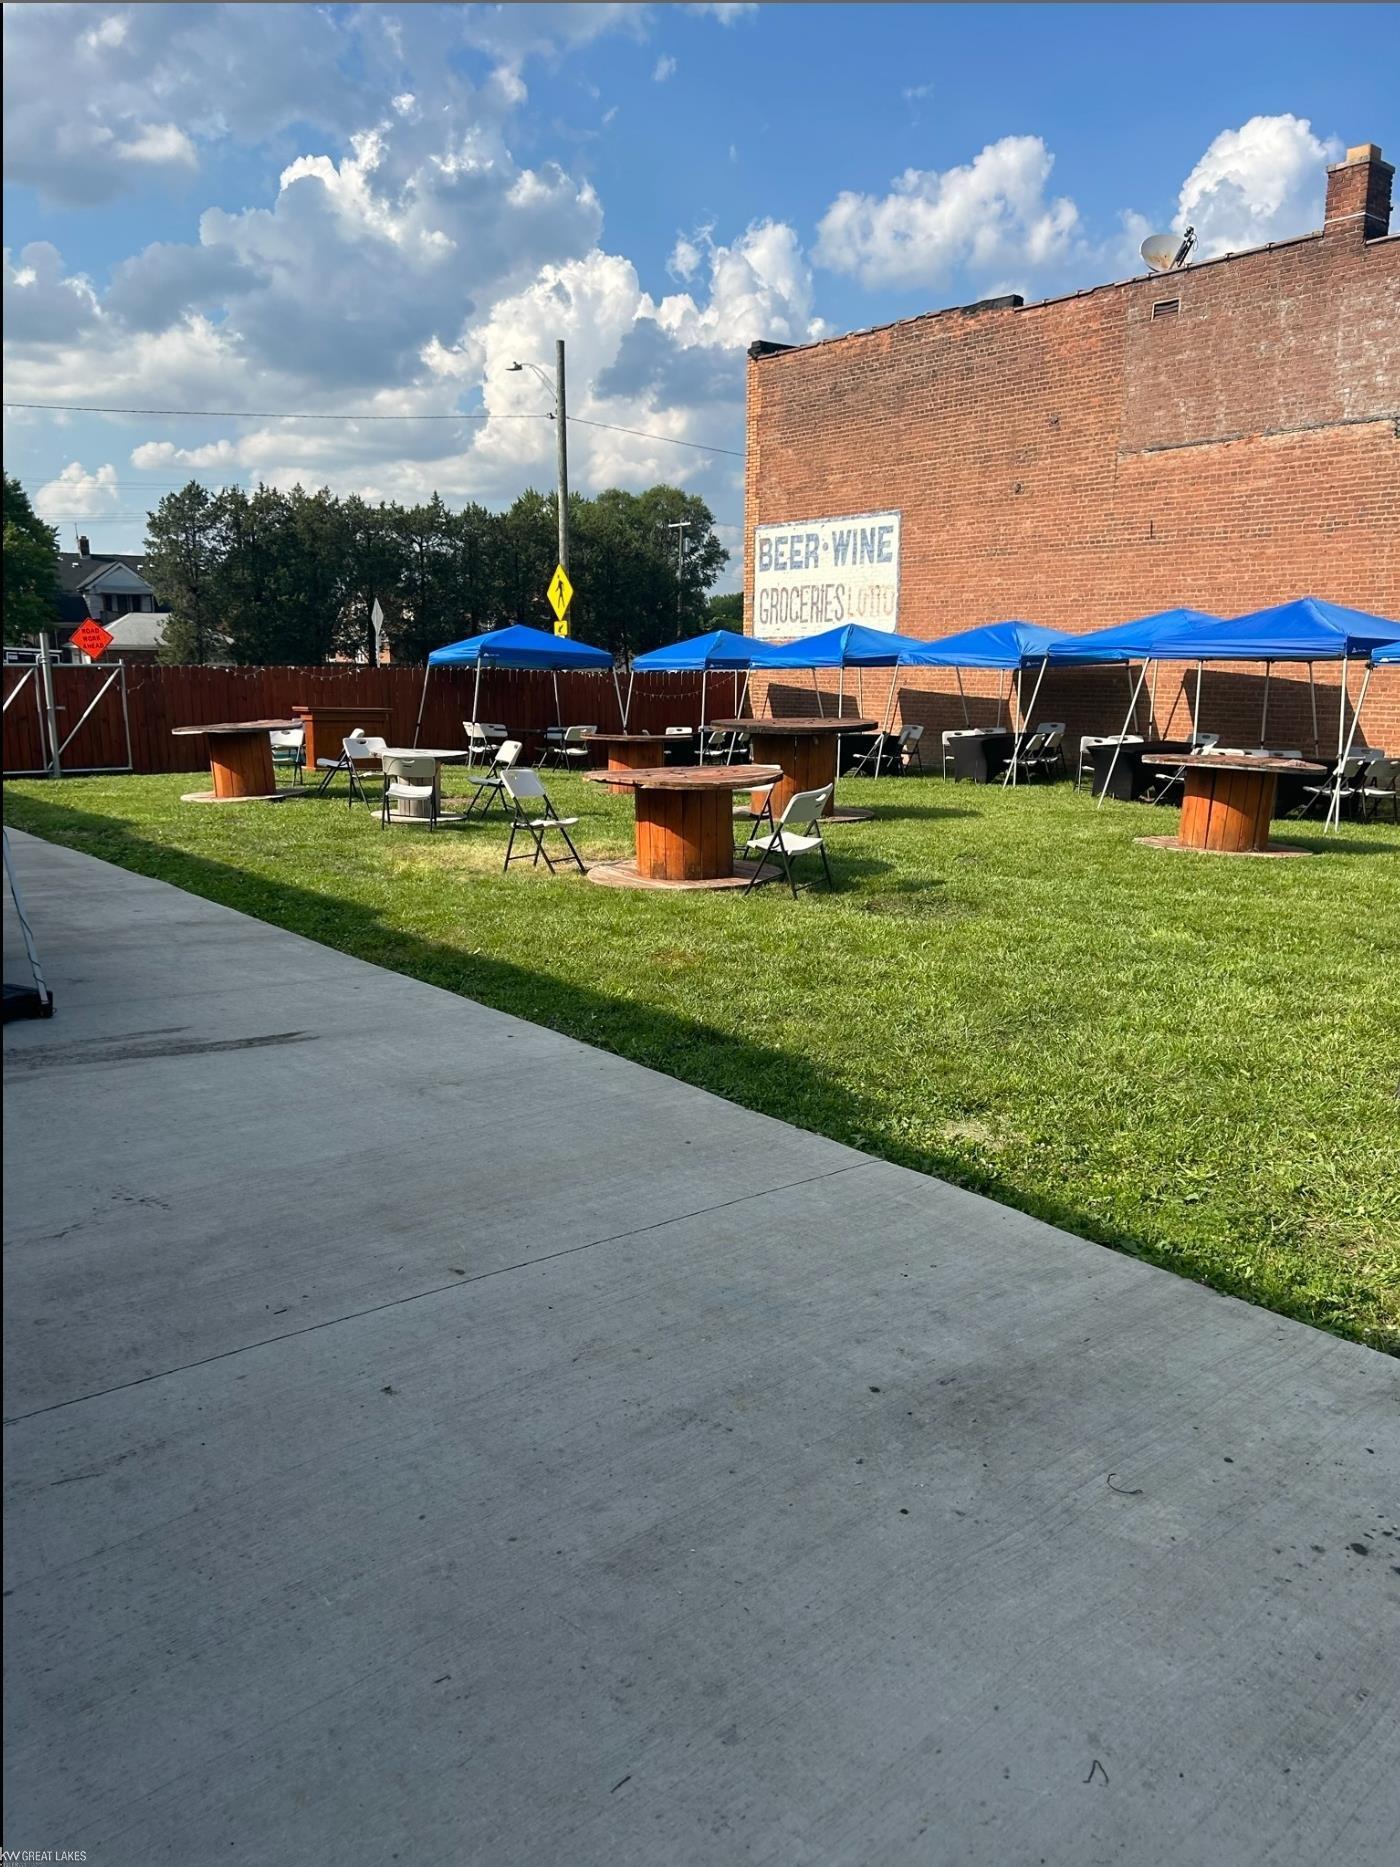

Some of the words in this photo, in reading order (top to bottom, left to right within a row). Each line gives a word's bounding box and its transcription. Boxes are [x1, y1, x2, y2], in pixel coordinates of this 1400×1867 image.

[758, 533, 820, 573] BEER
[832, 525, 894, 567] WINE
[759, 583, 846, 625] GROCERIES
